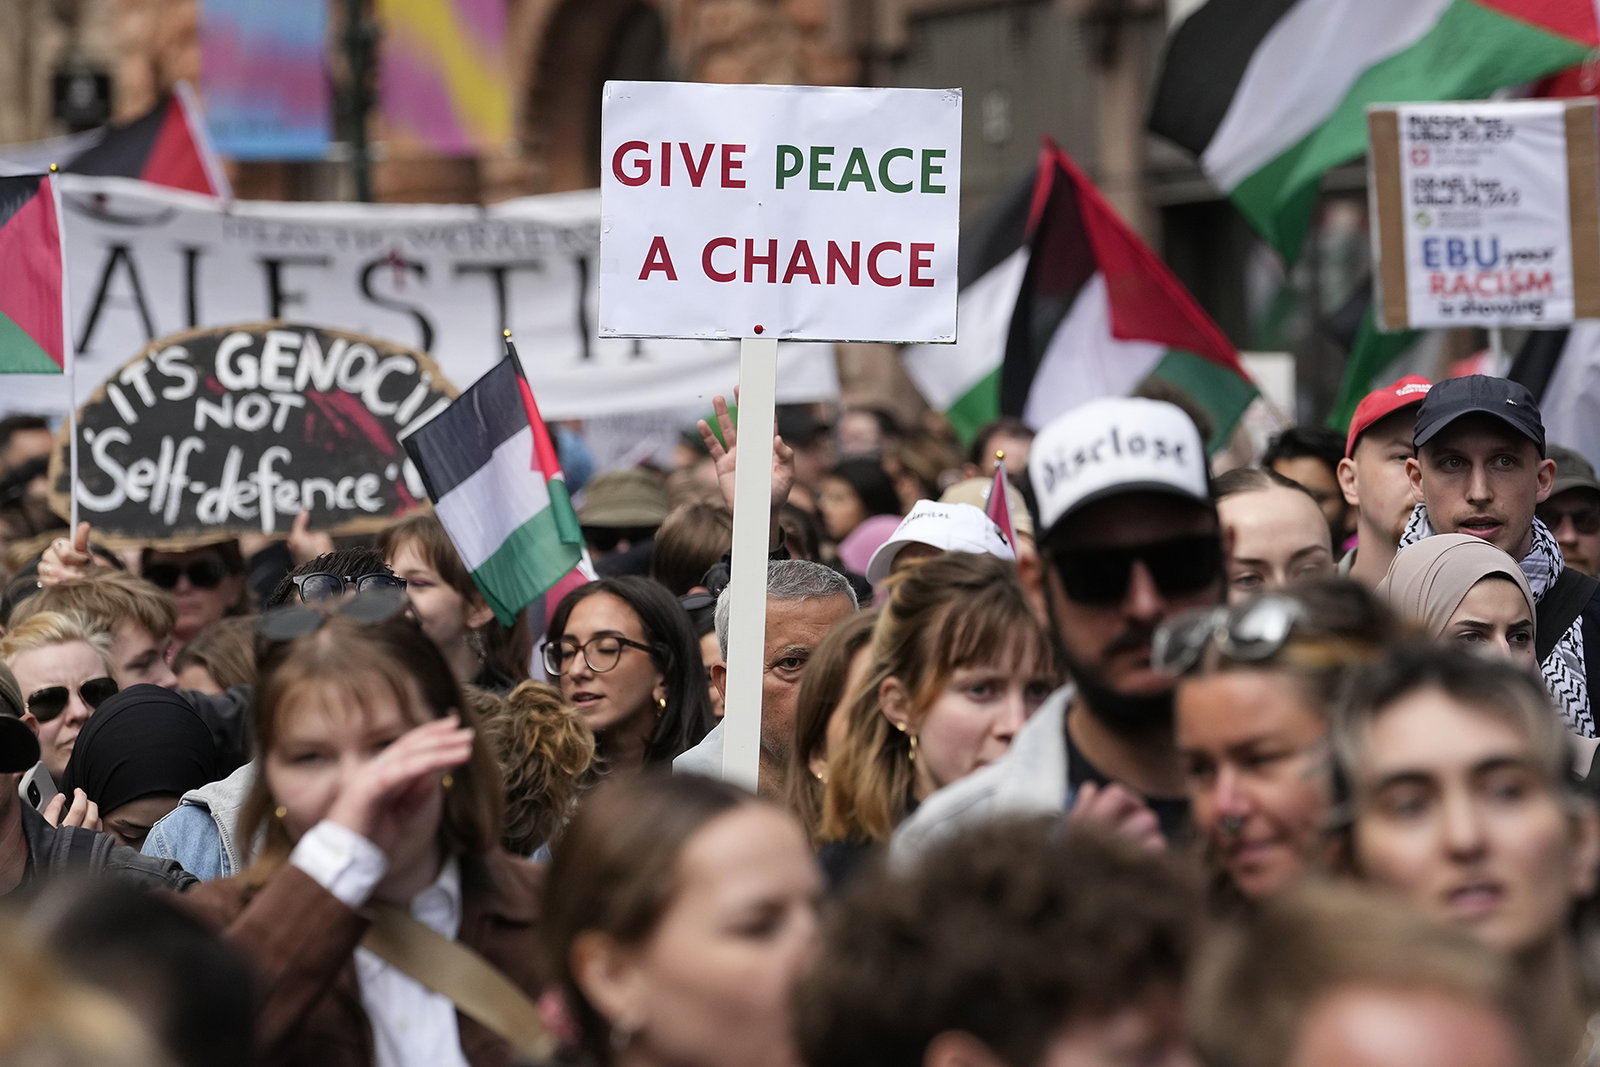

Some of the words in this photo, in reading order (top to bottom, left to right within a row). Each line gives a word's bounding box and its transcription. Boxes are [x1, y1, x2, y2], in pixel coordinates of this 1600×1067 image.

[611, 140, 747, 189] GIVE
[775, 144, 947, 194] PEACE
[638, 236, 678, 281] A
[701, 237, 936, 288] CHANCE
[1422, 236, 1500, 269] EBU
[1503, 247, 1556, 268] your
[1428, 269, 1555, 297] RACISM
[1460, 300, 1545, 321] showing
[215, 328, 452, 448] GENOCI
[194, 392, 306, 433] NOT
